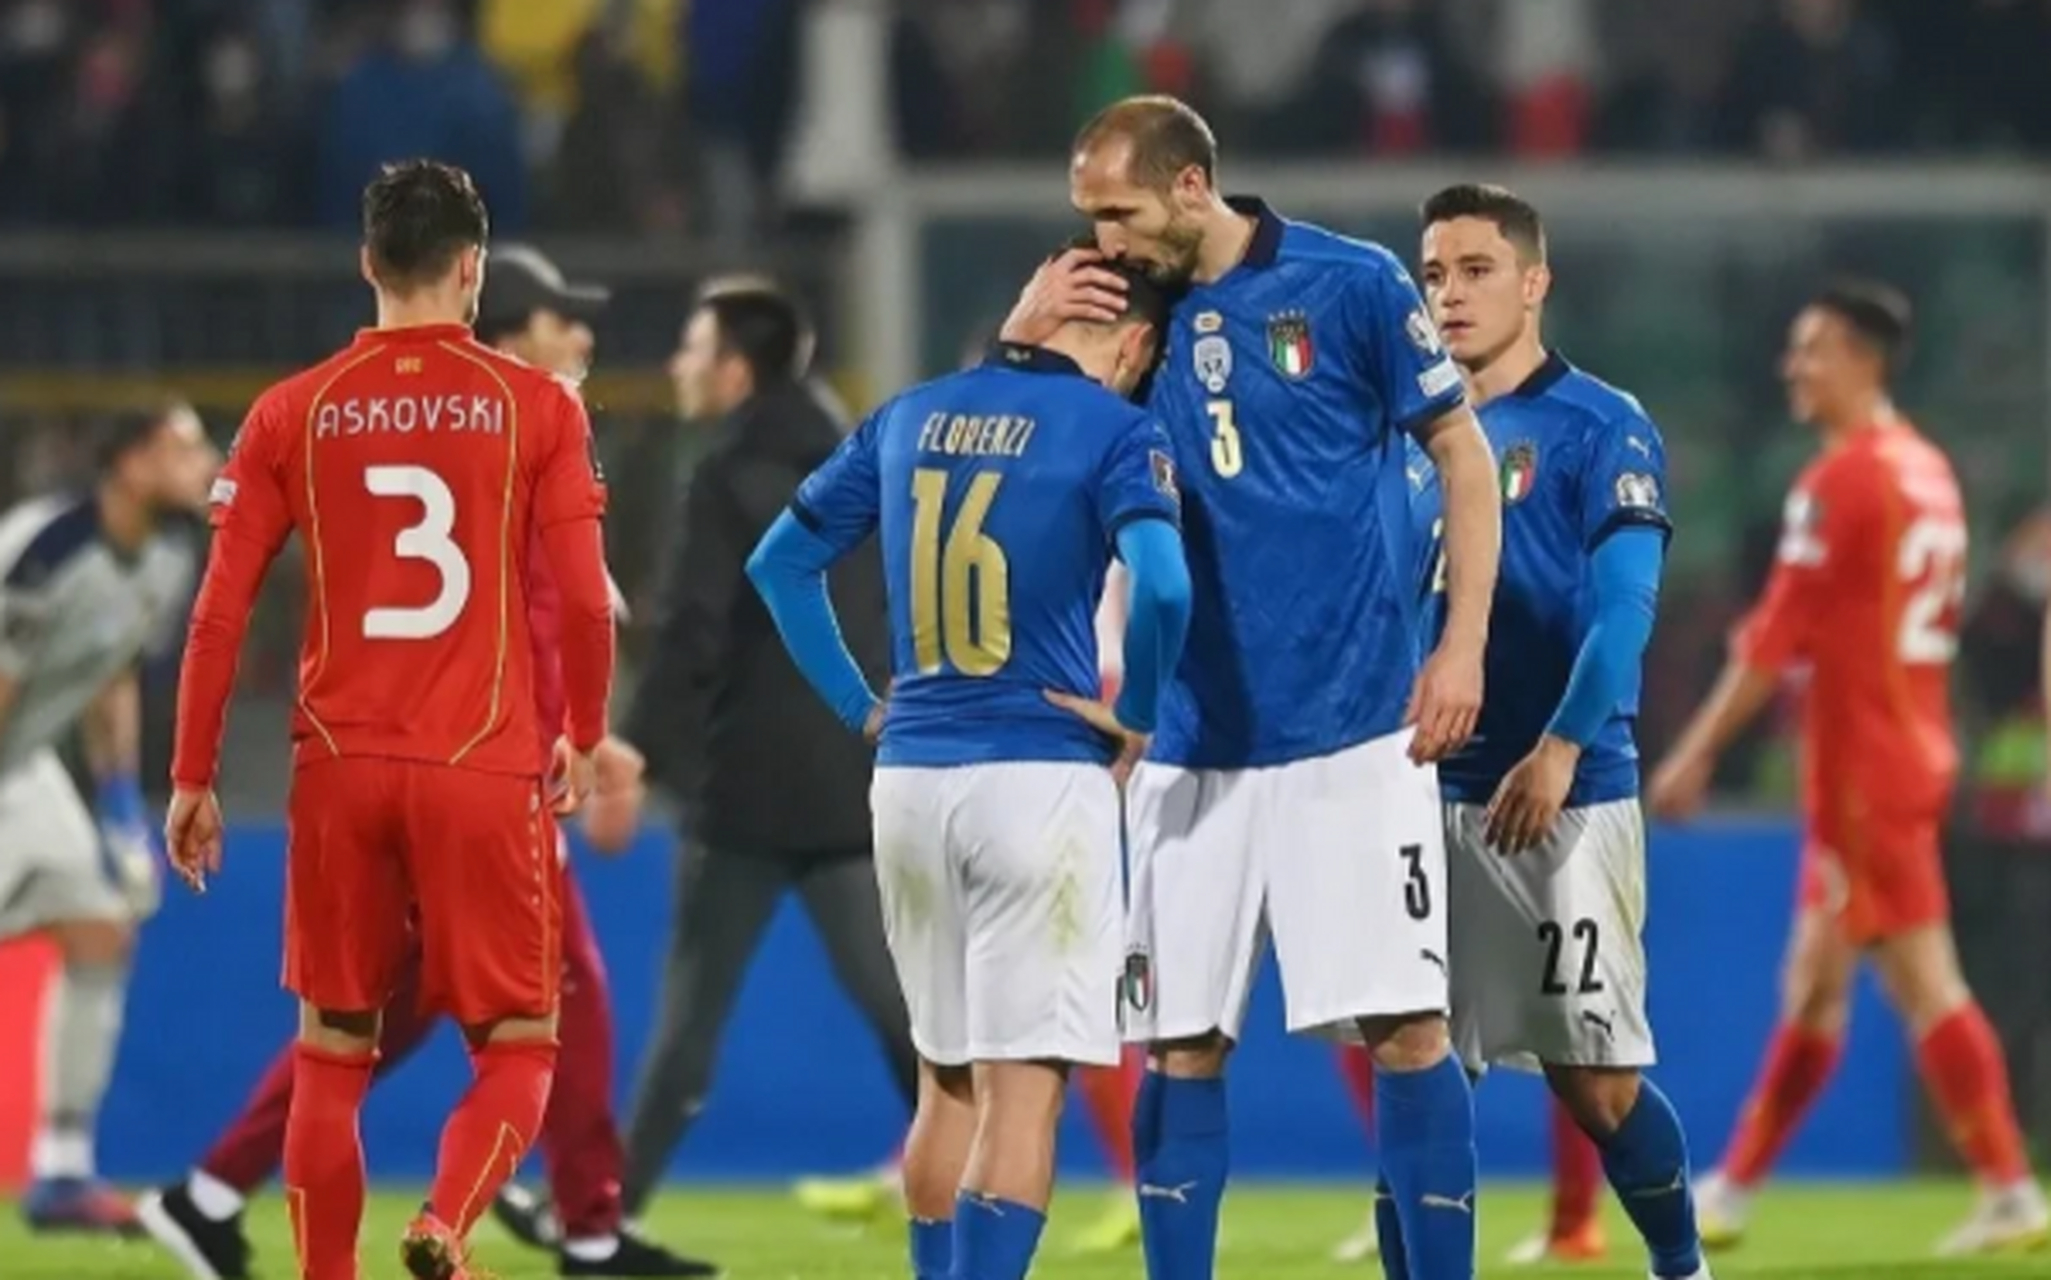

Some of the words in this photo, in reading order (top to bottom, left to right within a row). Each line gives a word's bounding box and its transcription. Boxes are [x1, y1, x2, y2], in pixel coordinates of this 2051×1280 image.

[316, 395, 503, 439] ASKOVSKI
[917, 412, 1035, 457] FLORENZI
[1206, 399, 1243, 479] 3
[363, 465, 471, 639] 3
[911, 467, 1011, 677] 16
[1399, 844, 1431, 920] 3
[1538, 918, 1604, 994] 22
